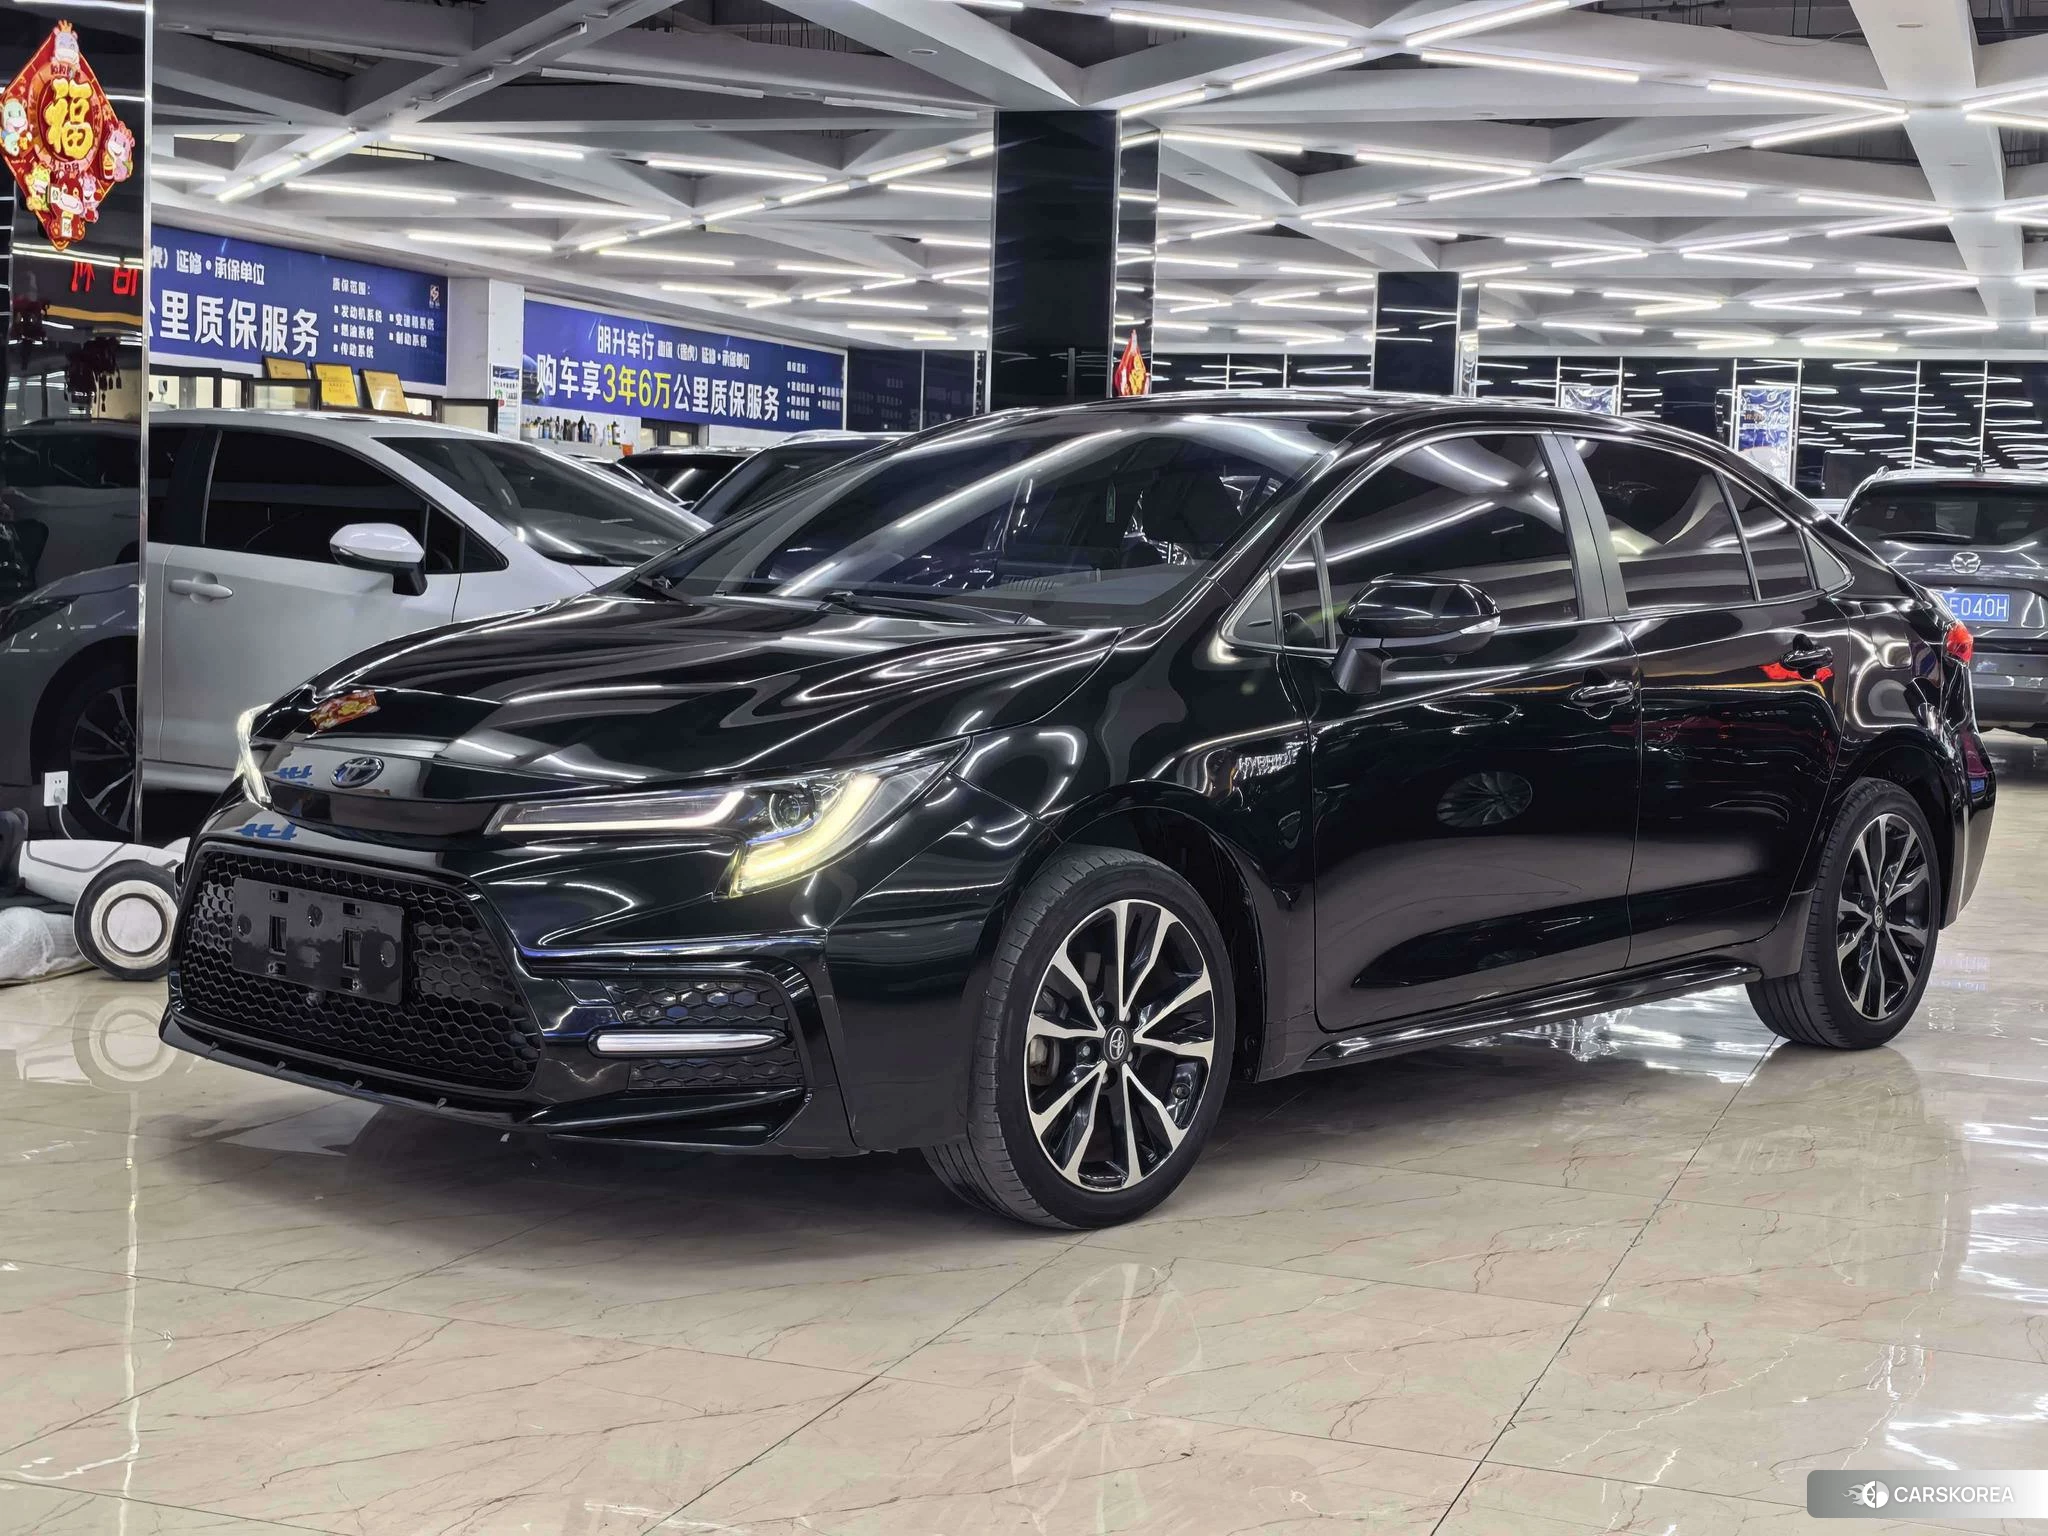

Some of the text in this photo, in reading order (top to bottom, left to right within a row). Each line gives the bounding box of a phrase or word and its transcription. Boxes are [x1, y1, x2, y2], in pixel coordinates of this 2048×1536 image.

[44, 78, 94, 160] 福
[597, 325, 655, 361] 明升车行
[536, 353, 780, 422] 购车享3年6万公里质保服务
[1949, 597, 2008, 617] E040H
